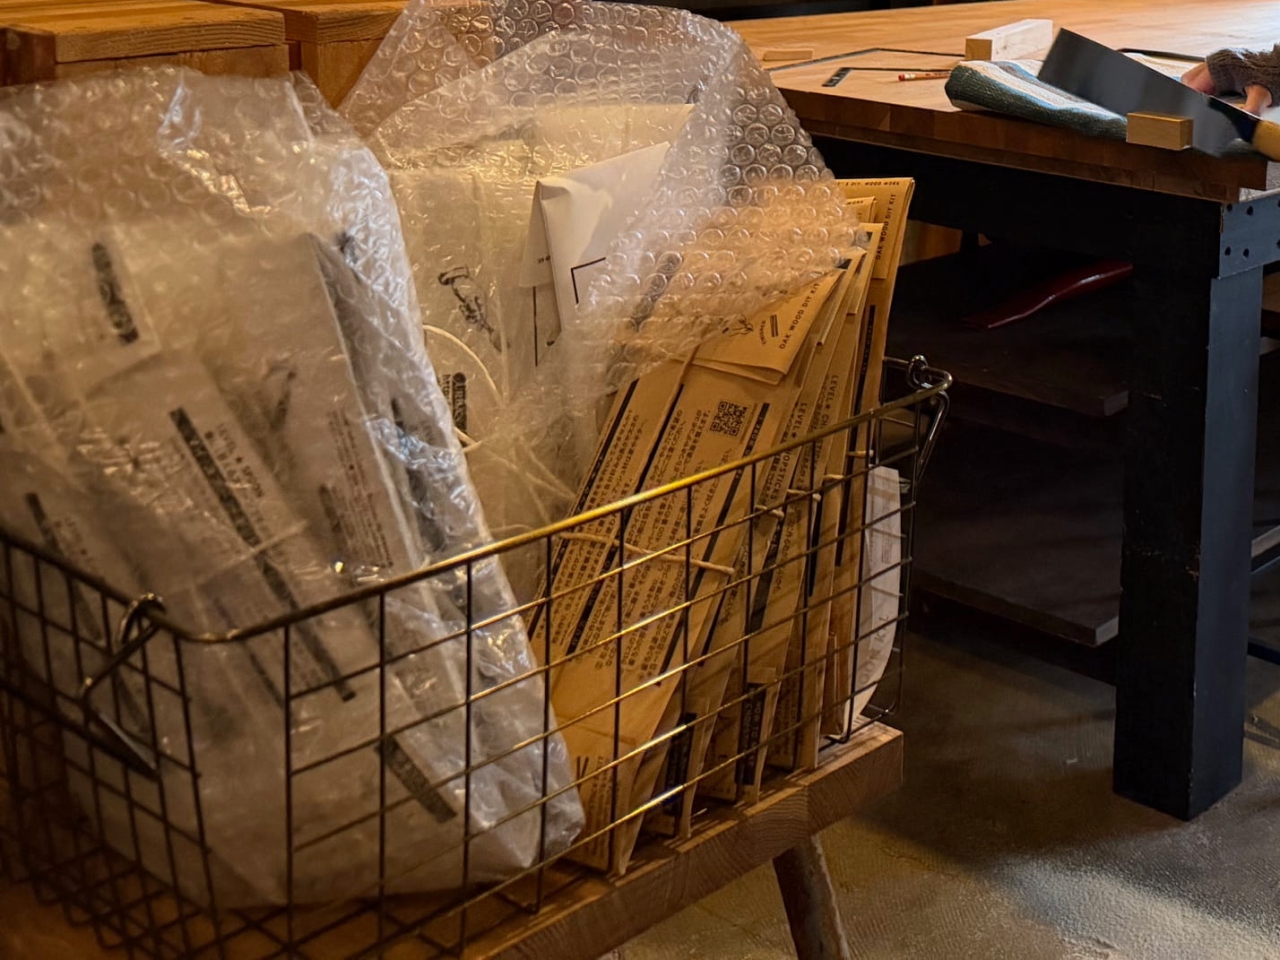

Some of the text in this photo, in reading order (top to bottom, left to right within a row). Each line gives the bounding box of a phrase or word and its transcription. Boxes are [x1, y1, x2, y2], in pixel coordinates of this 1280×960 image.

[880, 221, 889, 242] WOOD
[885, 208, 893, 219] DIY
[779, 283, 820, 349] OAK WOOD DIY KIT
[828, 374, 839, 401] LEVEL
[793, 403, 807, 431] LEVEL
[242, 465, 265, 498] SPOON
